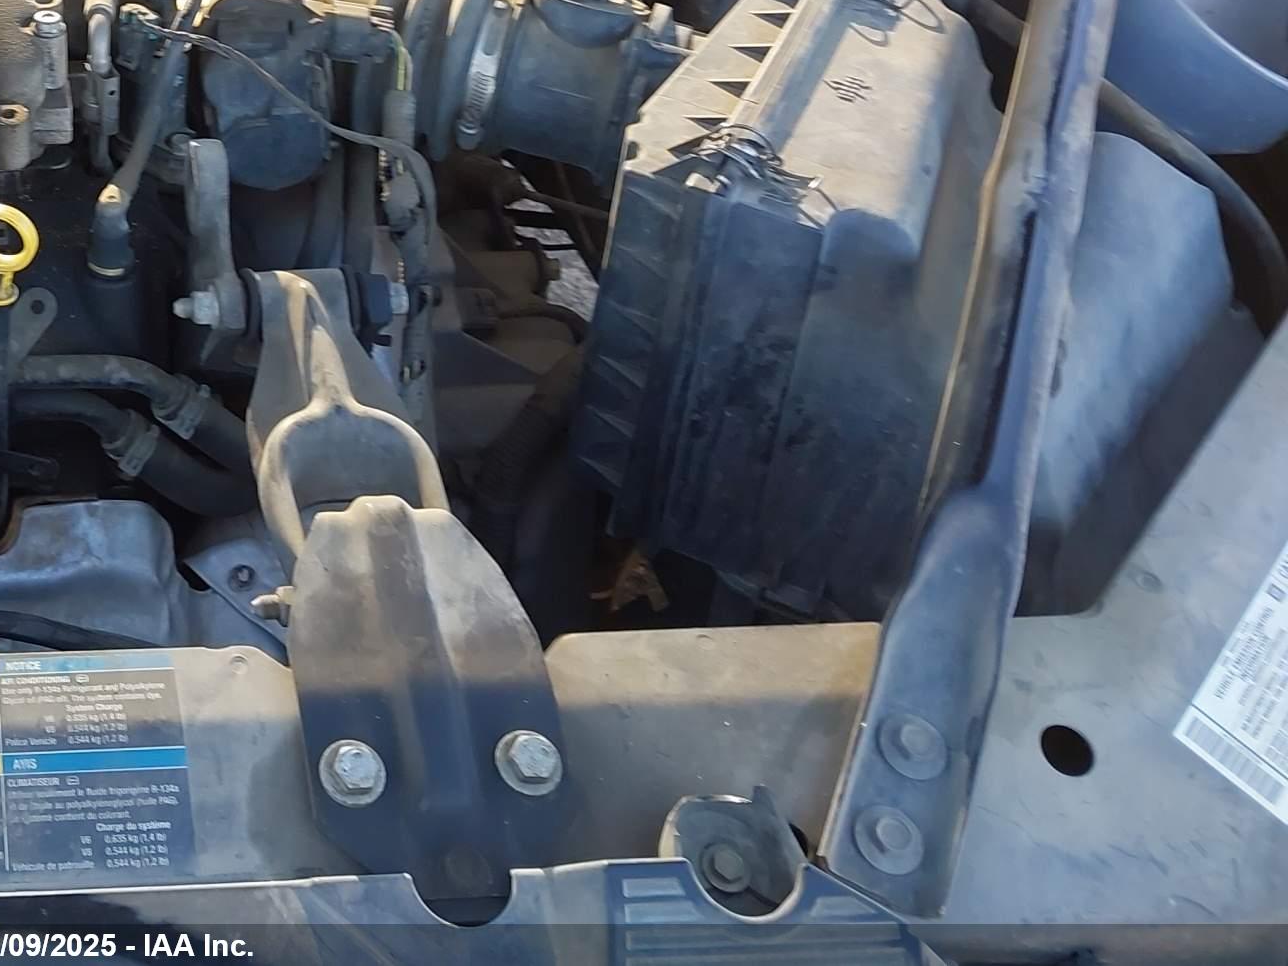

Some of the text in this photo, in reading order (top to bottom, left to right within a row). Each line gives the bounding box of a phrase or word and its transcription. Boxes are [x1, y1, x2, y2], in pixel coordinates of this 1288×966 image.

[5, 661, 40, 671] NOTICE
[12, 760, 38, 770] AVIS
[96, 822, 124, 832] Charge
[126, 822, 136, 830] du
[128, 835, 139, 844] kg
[129, 847, 140, 856] kg
[106, 859, 130, 868] 0.544
[130, 859, 141, 868] kg
